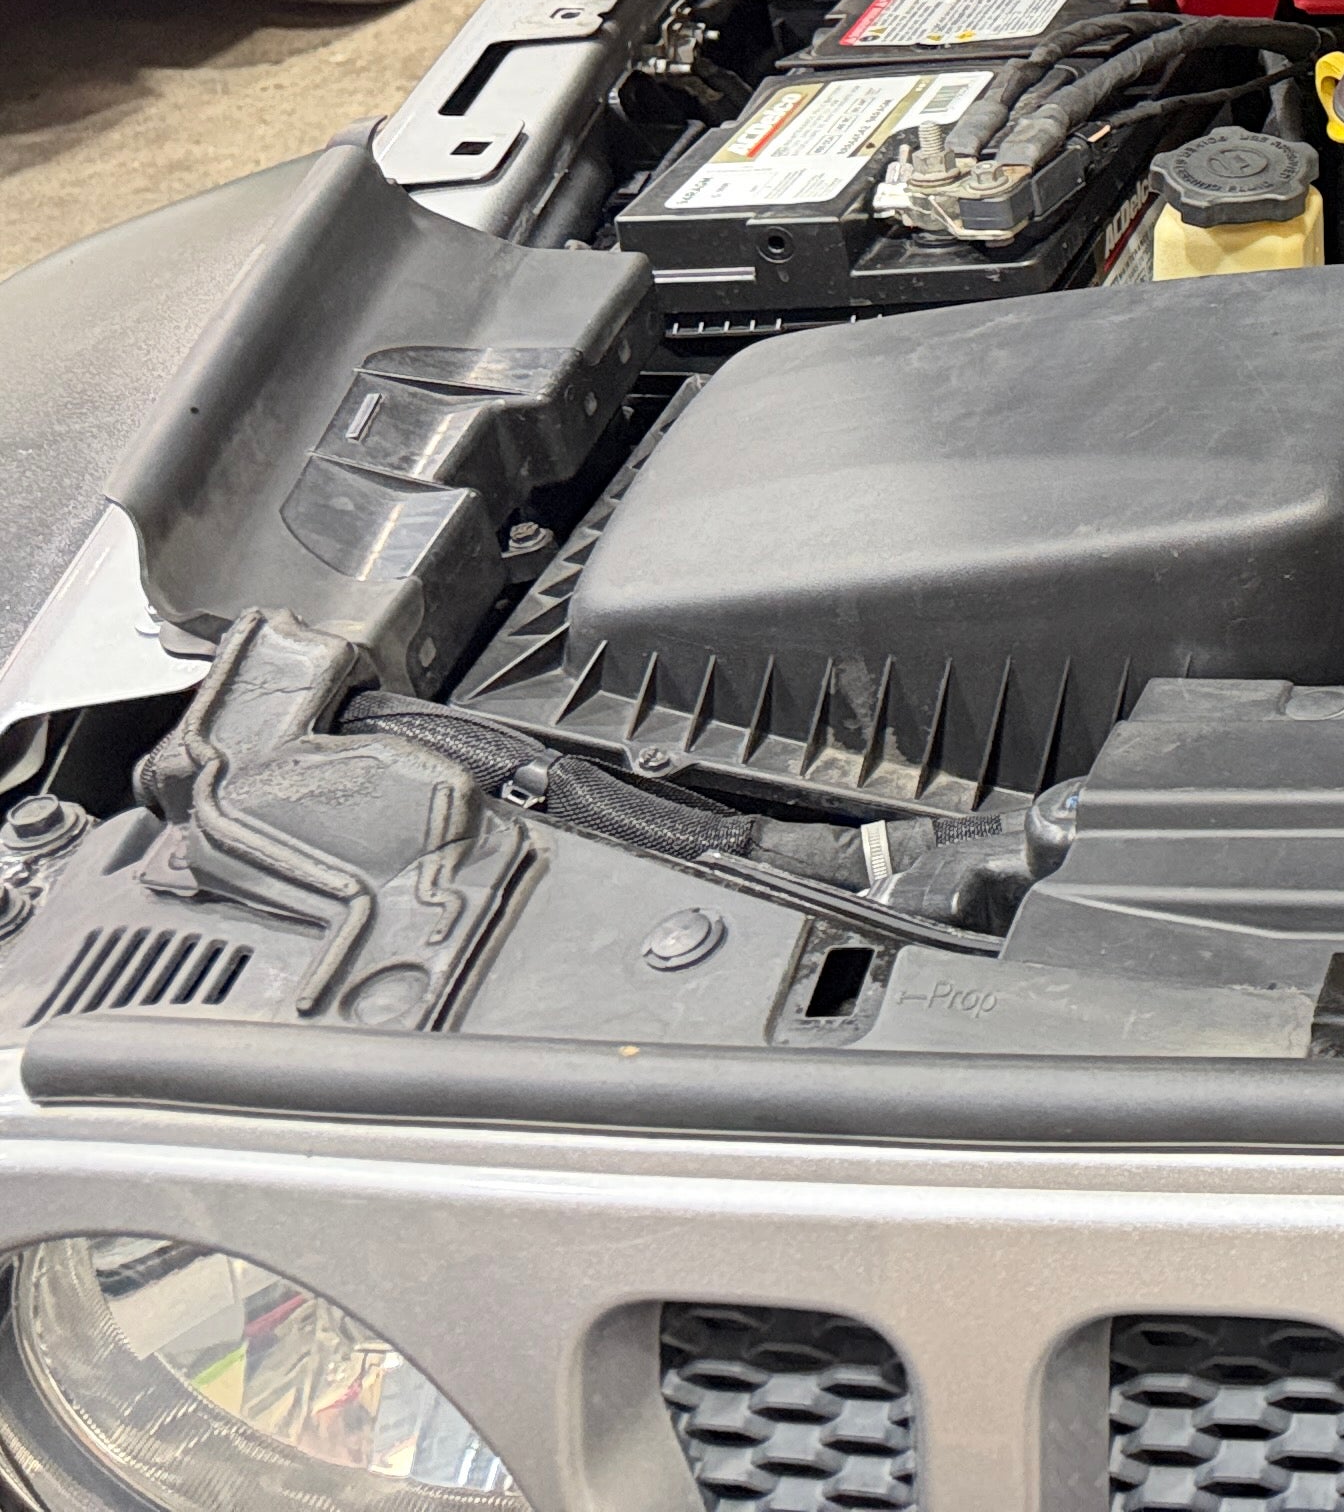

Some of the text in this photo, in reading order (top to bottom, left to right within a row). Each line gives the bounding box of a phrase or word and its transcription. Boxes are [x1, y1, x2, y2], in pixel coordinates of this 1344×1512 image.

[728, 92, 802, 155] ACDelco
[1104, 178, 1151, 259] ACDelc
[928, 980, 998, 1019] Prop
